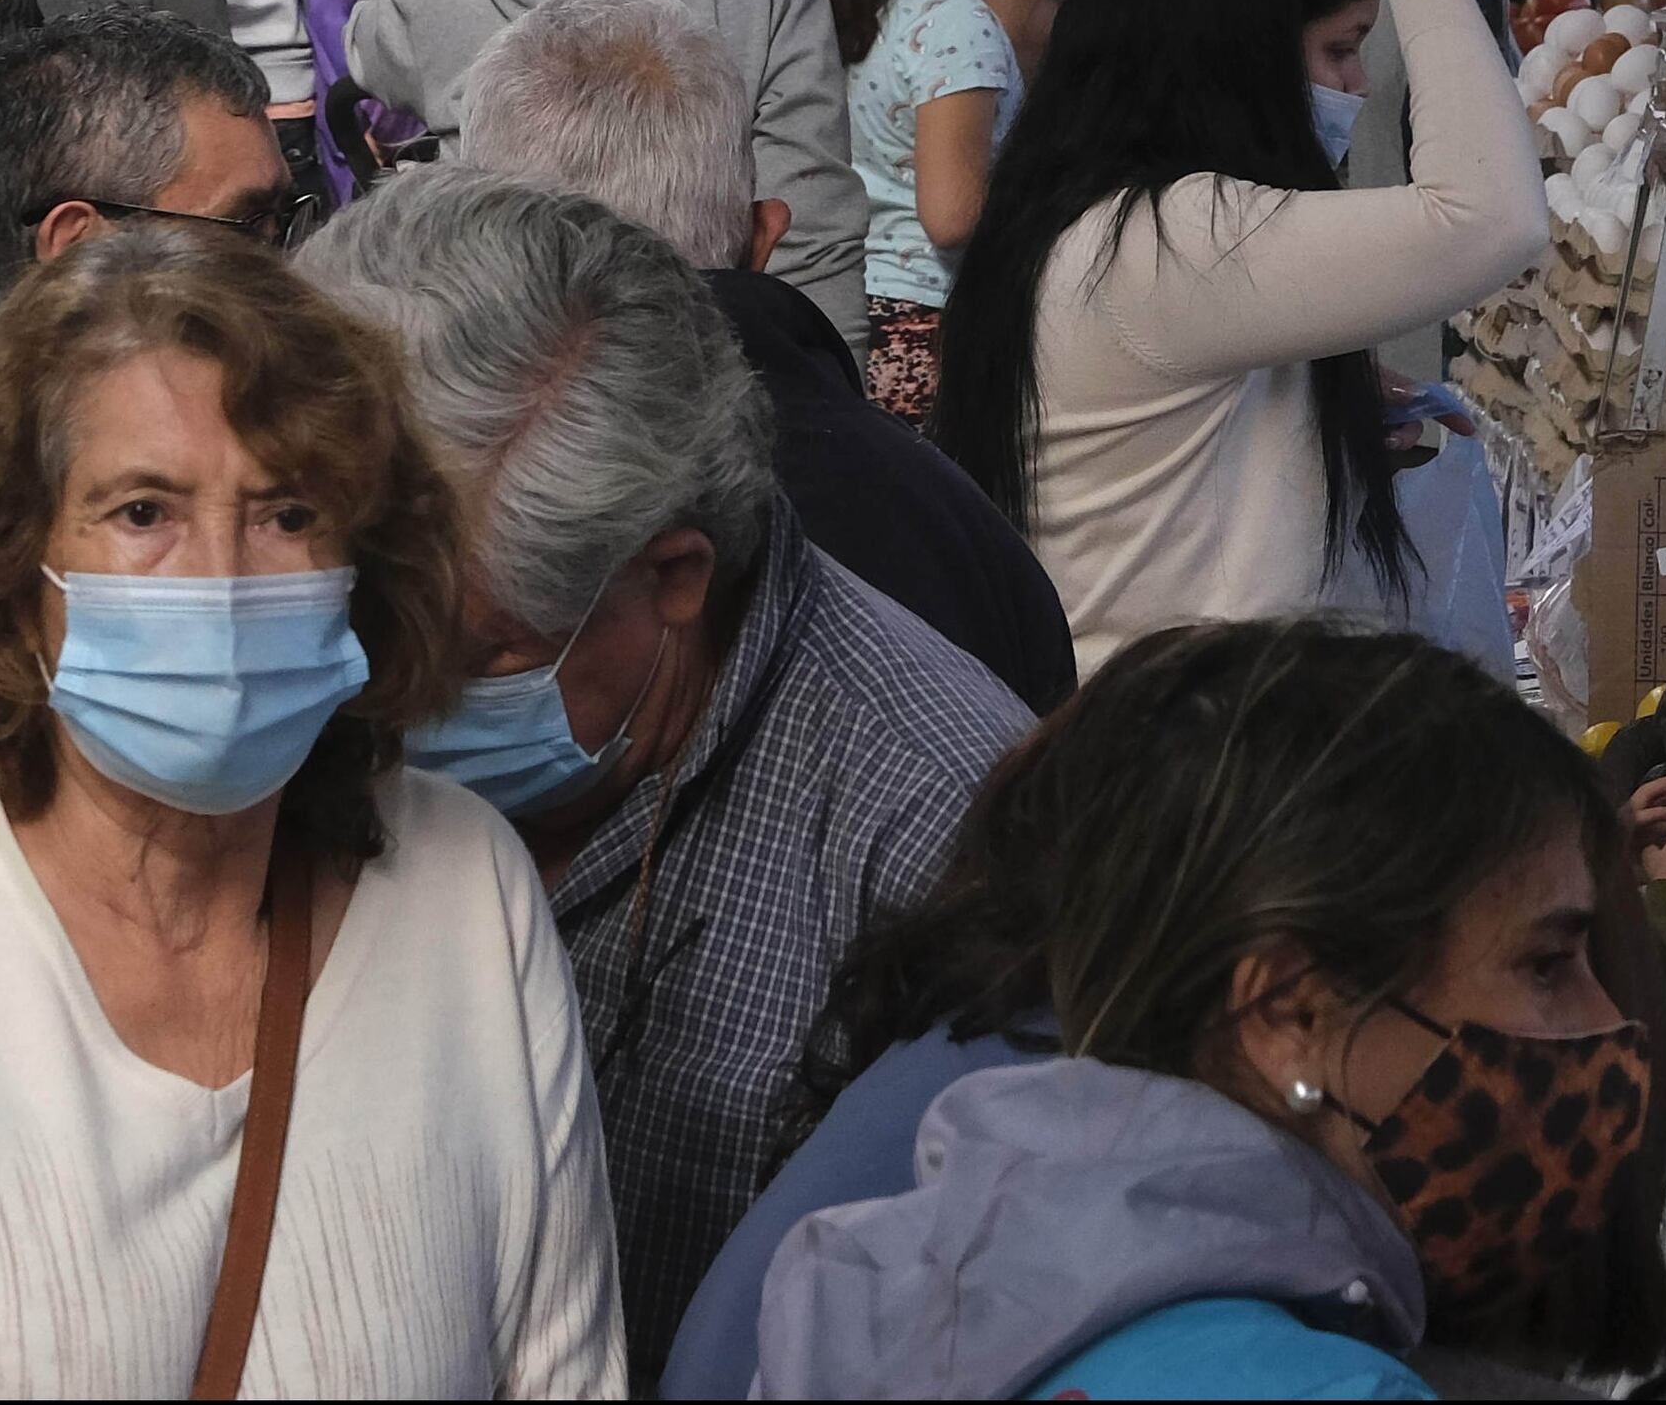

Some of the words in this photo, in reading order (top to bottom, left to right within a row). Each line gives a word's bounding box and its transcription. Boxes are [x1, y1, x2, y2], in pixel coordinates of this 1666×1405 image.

[1643, 499, 1655, 529] Col
[1641, 535, 1655, 591] Blanco
[1638, 600, 1654, 678] Unidades
